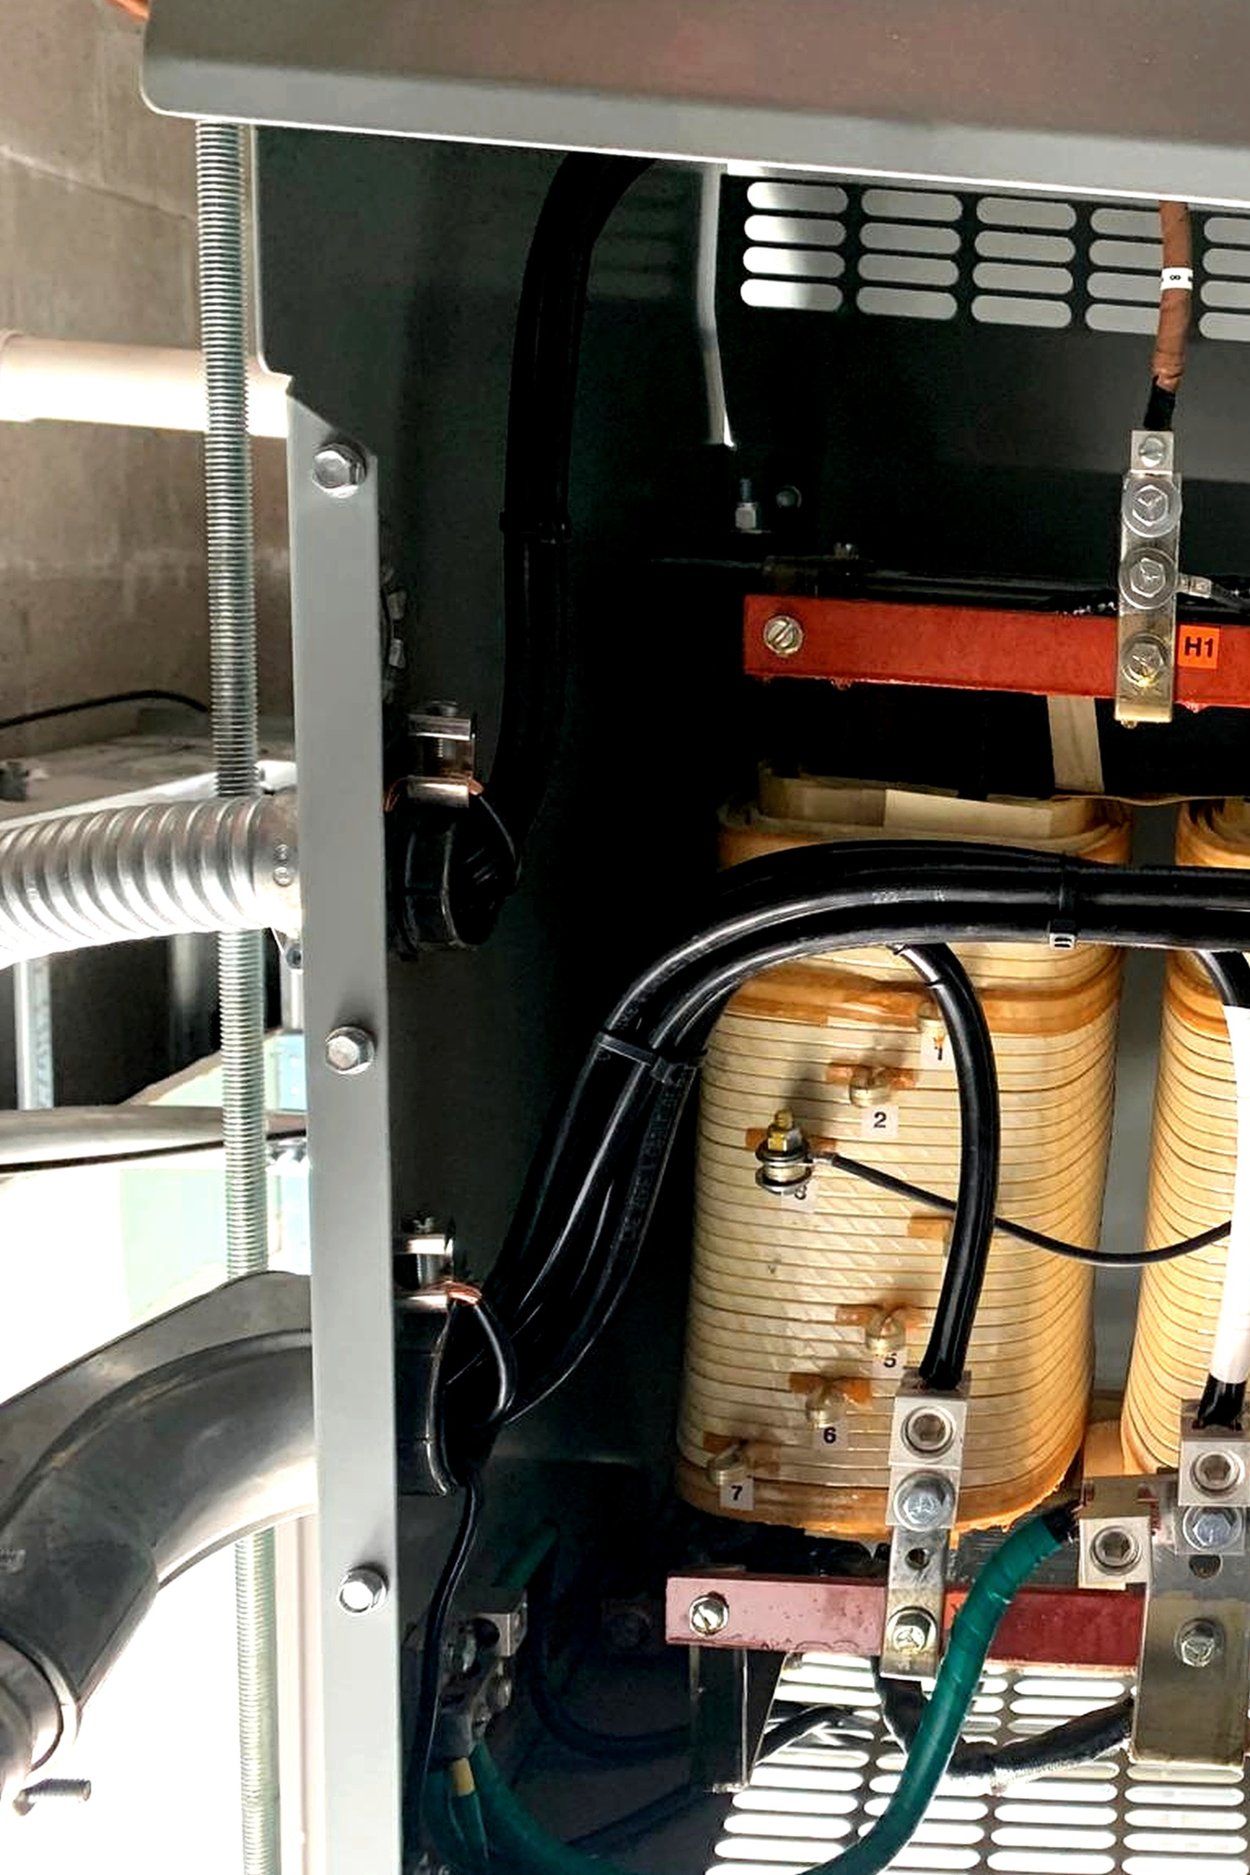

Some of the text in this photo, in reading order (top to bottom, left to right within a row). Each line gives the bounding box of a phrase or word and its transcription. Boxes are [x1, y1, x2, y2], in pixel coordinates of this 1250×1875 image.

[1184, 636, 1214, 658] H1
[873, 1111, 887, 1129] 2
[823, 1426, 837, 1444] 6
[731, 1484, 743, 1501] 7
